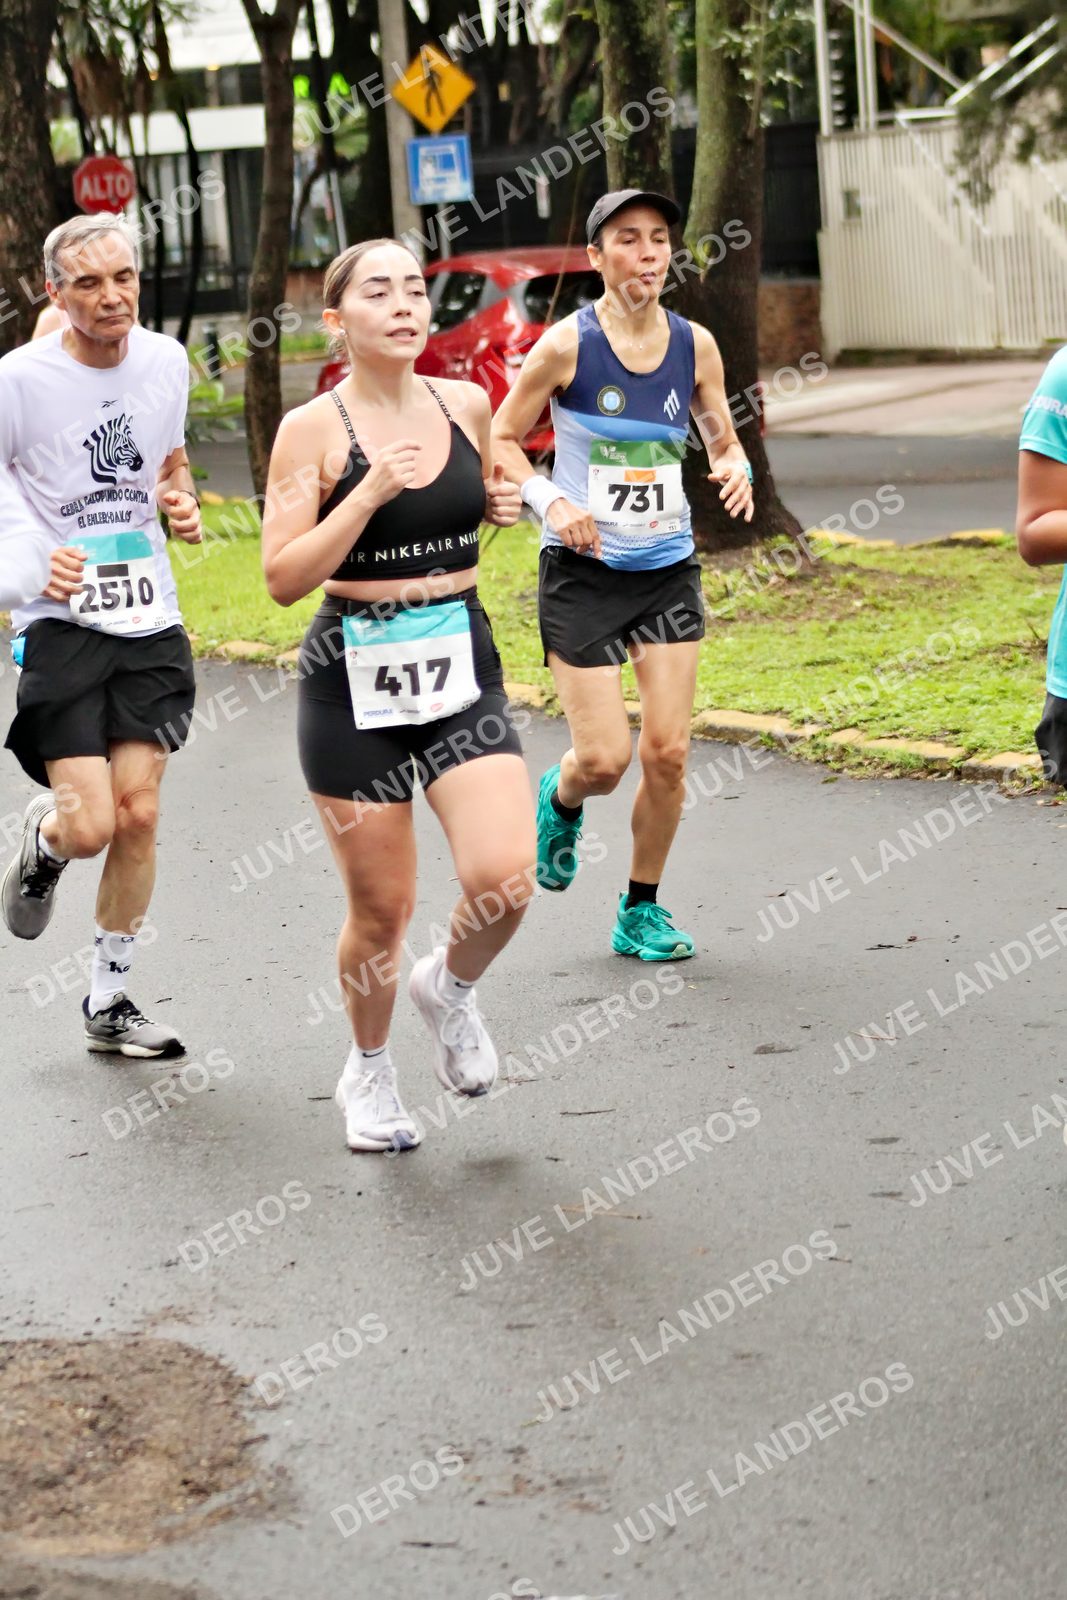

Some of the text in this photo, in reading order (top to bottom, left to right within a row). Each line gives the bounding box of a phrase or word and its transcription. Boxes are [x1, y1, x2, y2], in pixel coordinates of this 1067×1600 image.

[81, 173, 129, 199] ALTO
[608, 483, 664, 514] 731
[78, 515, 87, 529] EL
[79, 576, 154, 614] 2510
[375, 656, 452, 697] 417
